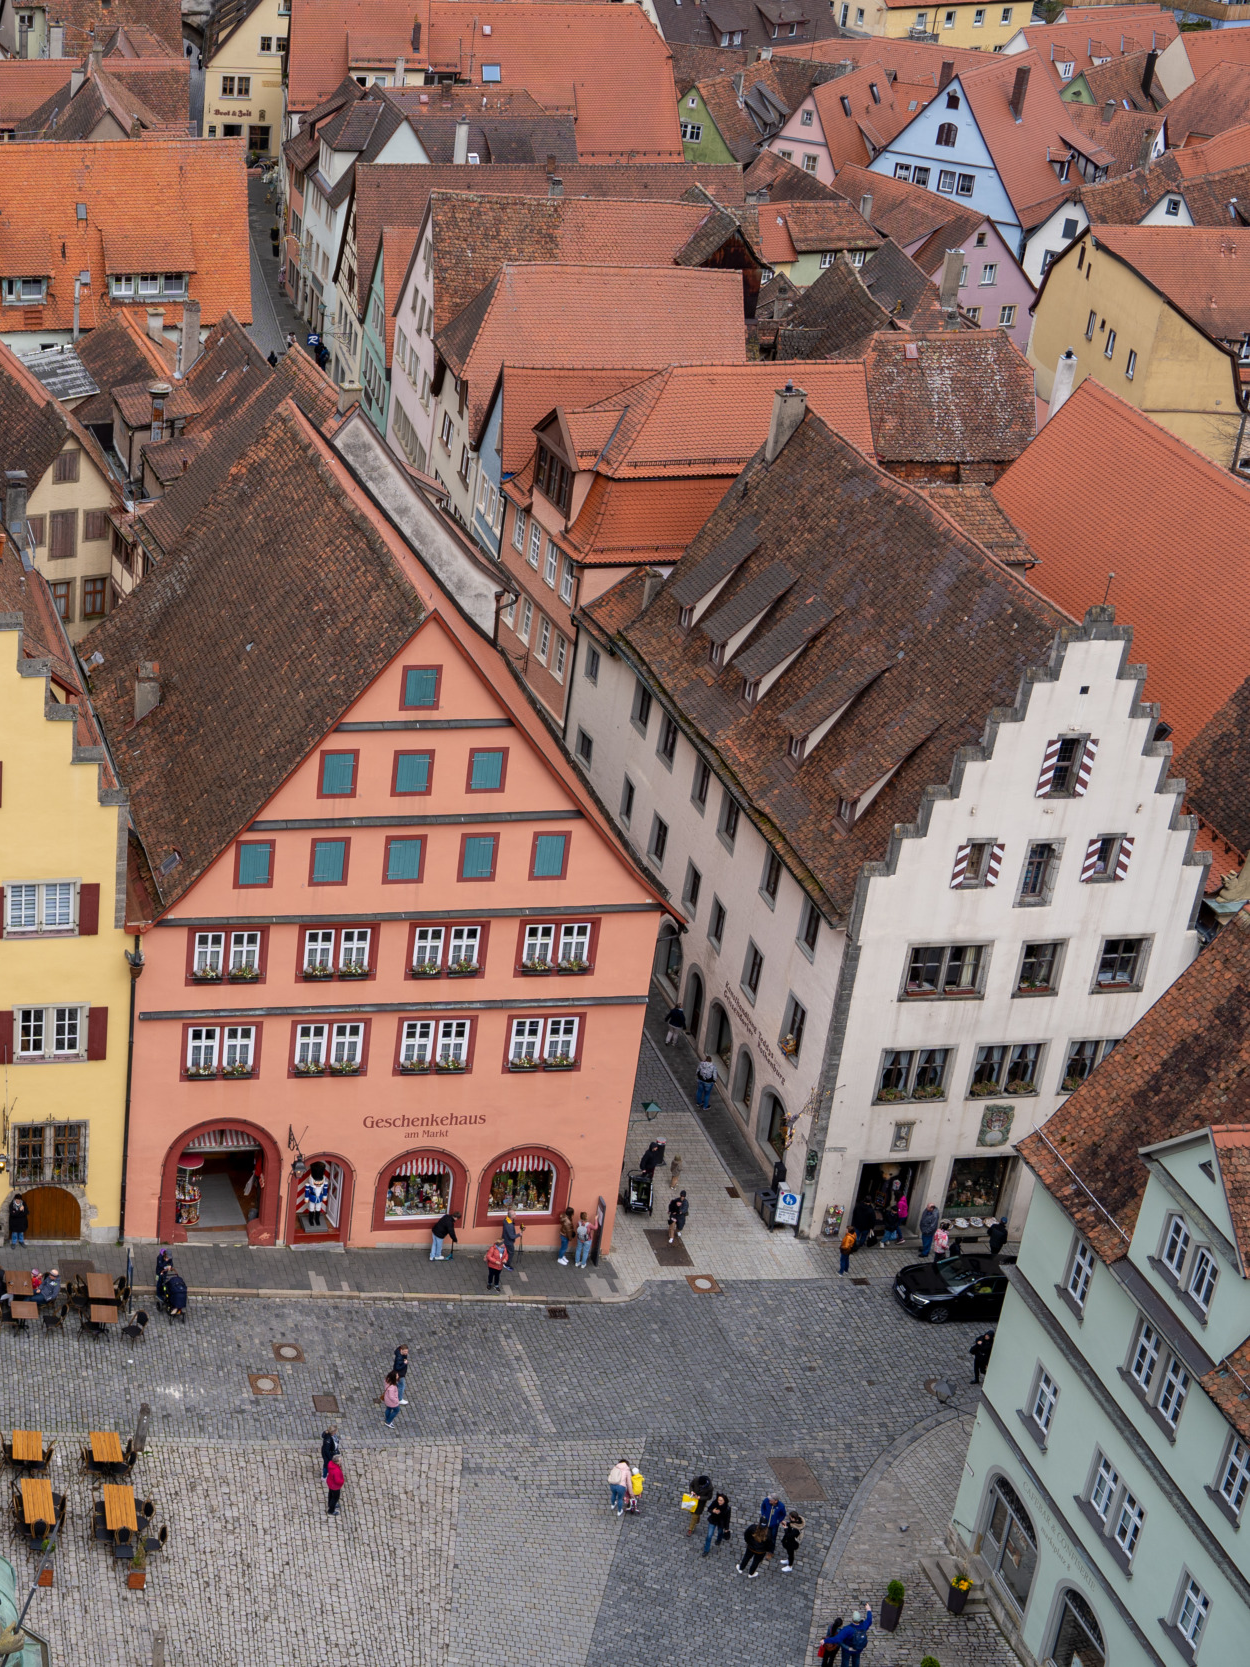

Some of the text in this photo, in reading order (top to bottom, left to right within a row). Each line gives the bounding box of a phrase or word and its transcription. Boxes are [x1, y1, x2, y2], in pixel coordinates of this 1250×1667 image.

[363, 1112, 487, 1129] Geschenkehaus
[422, 1129, 449, 1138] Markt
[1056, 1532, 1096, 1592] CONFISERIE
